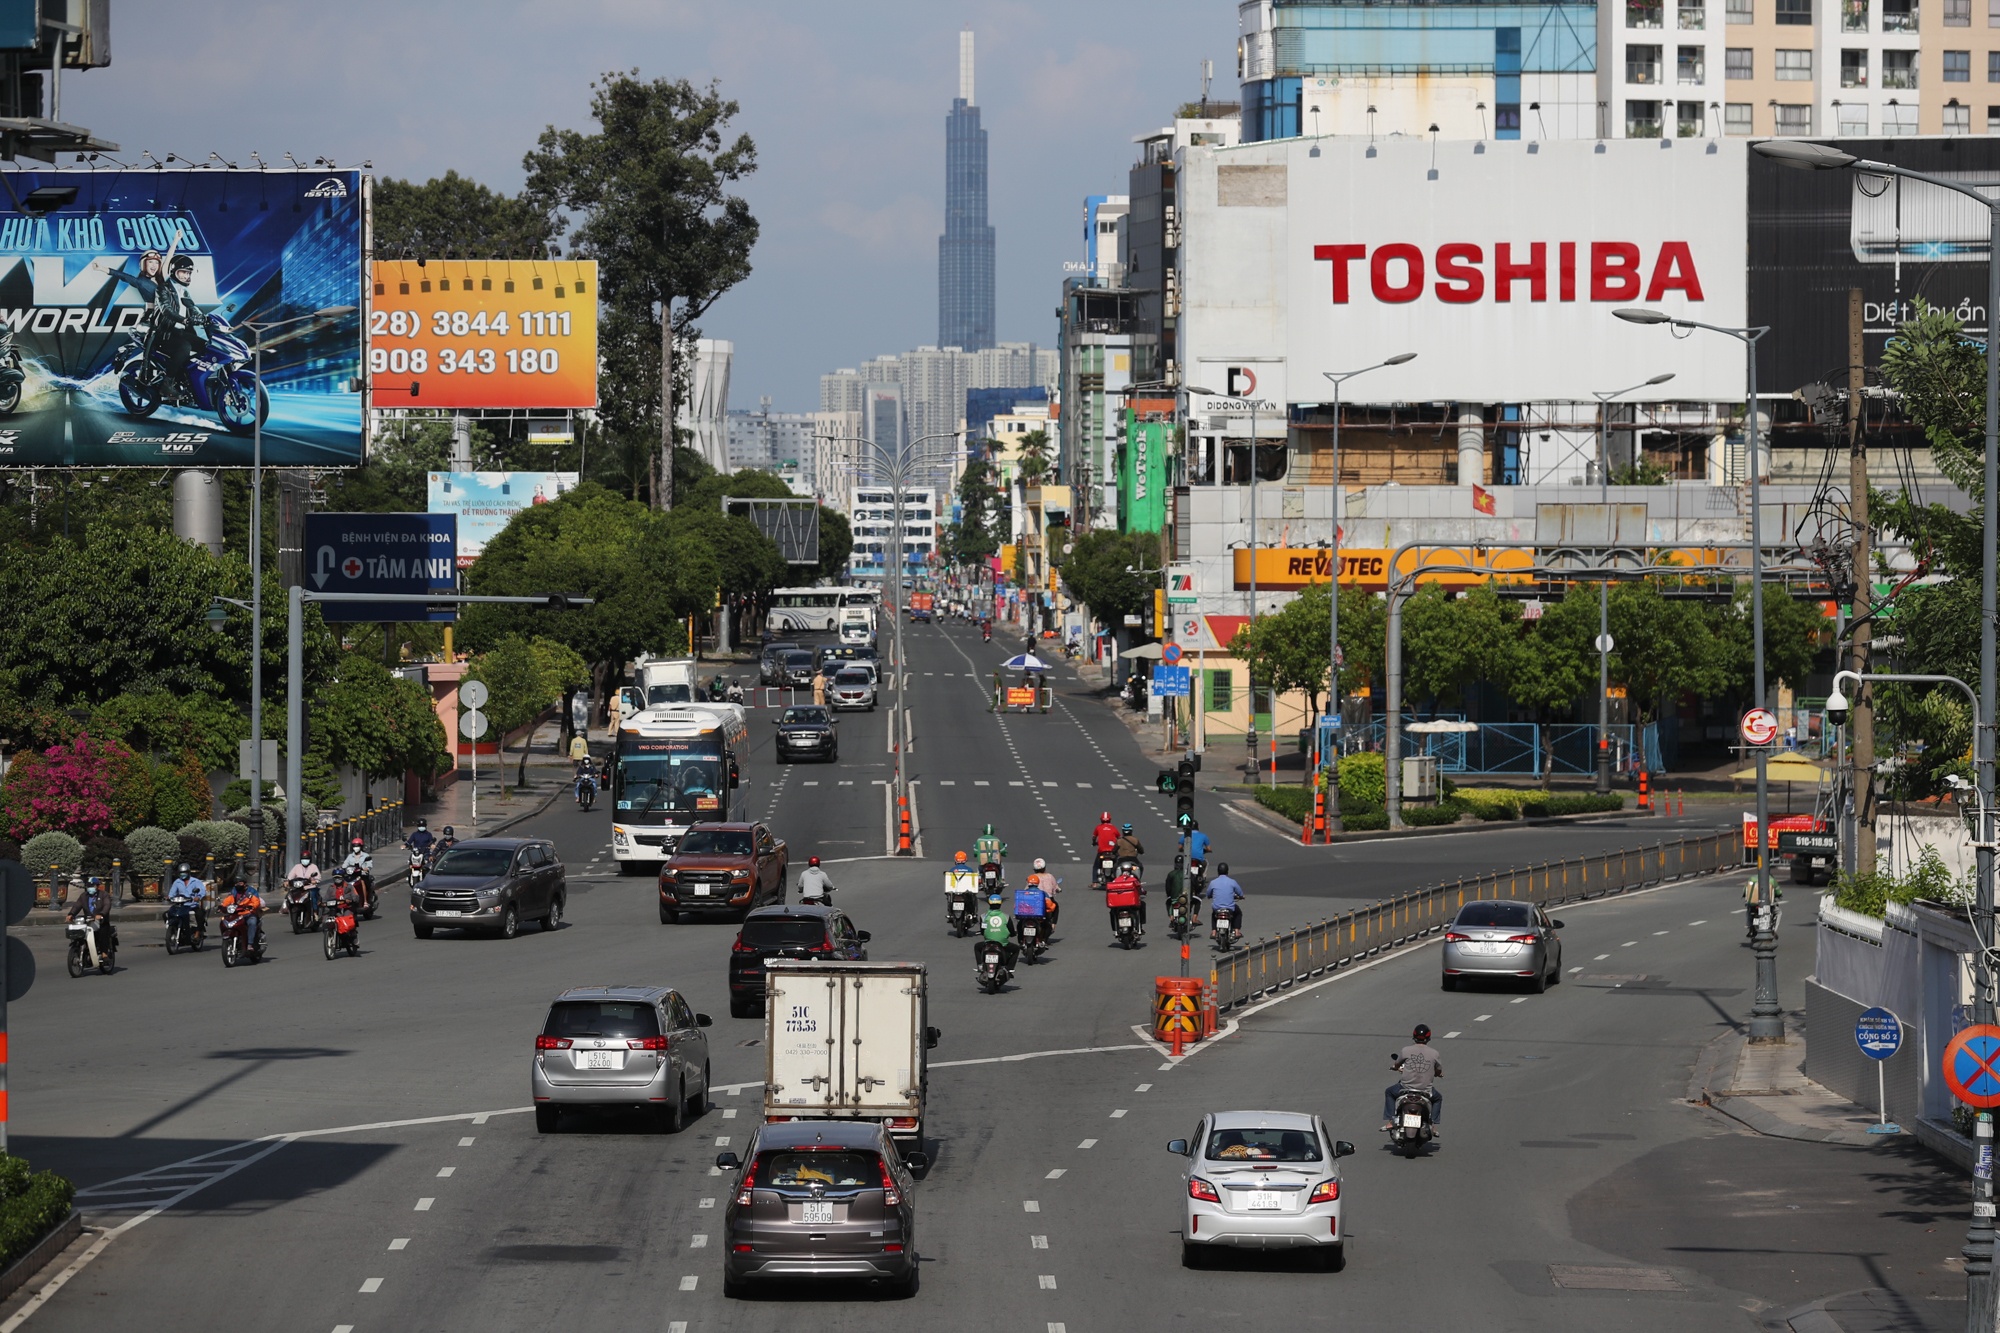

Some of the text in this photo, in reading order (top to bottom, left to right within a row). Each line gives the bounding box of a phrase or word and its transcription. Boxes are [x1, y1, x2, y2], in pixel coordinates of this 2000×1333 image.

[57, 214, 106, 250] KHÓ
[117, 213, 200, 250] CƯỠNG
[0, 255, 223, 305] VA
[1313, 241, 1705, 304] TOSHIBA
[0, 307, 147, 333] WORLD
[432, 310, 510, 336] 3844
[519, 310, 572, 336] 1111
[1864, 297, 1986, 326] Diệt huẩn
[371, 348, 559, 374] 908 343 180
[164, 432, 212, 443] 155
[1136, 429, 1147, 501] WeTrek
[342, 531, 451, 545] BỆNH VIỆN ĐA KHOA
[366, 554, 451, 579] TÂM ANH
[792, 1005, 810, 1018] 51C
[785, 1019, 817, 1032] 773.53
[1858, 1030, 1880, 1040] CỔNG
[1881, 1031, 1891, 1040] SỐ
[804, 1212, 832, 1222] 595.09
[809, 1203, 825, 1213] 51F
